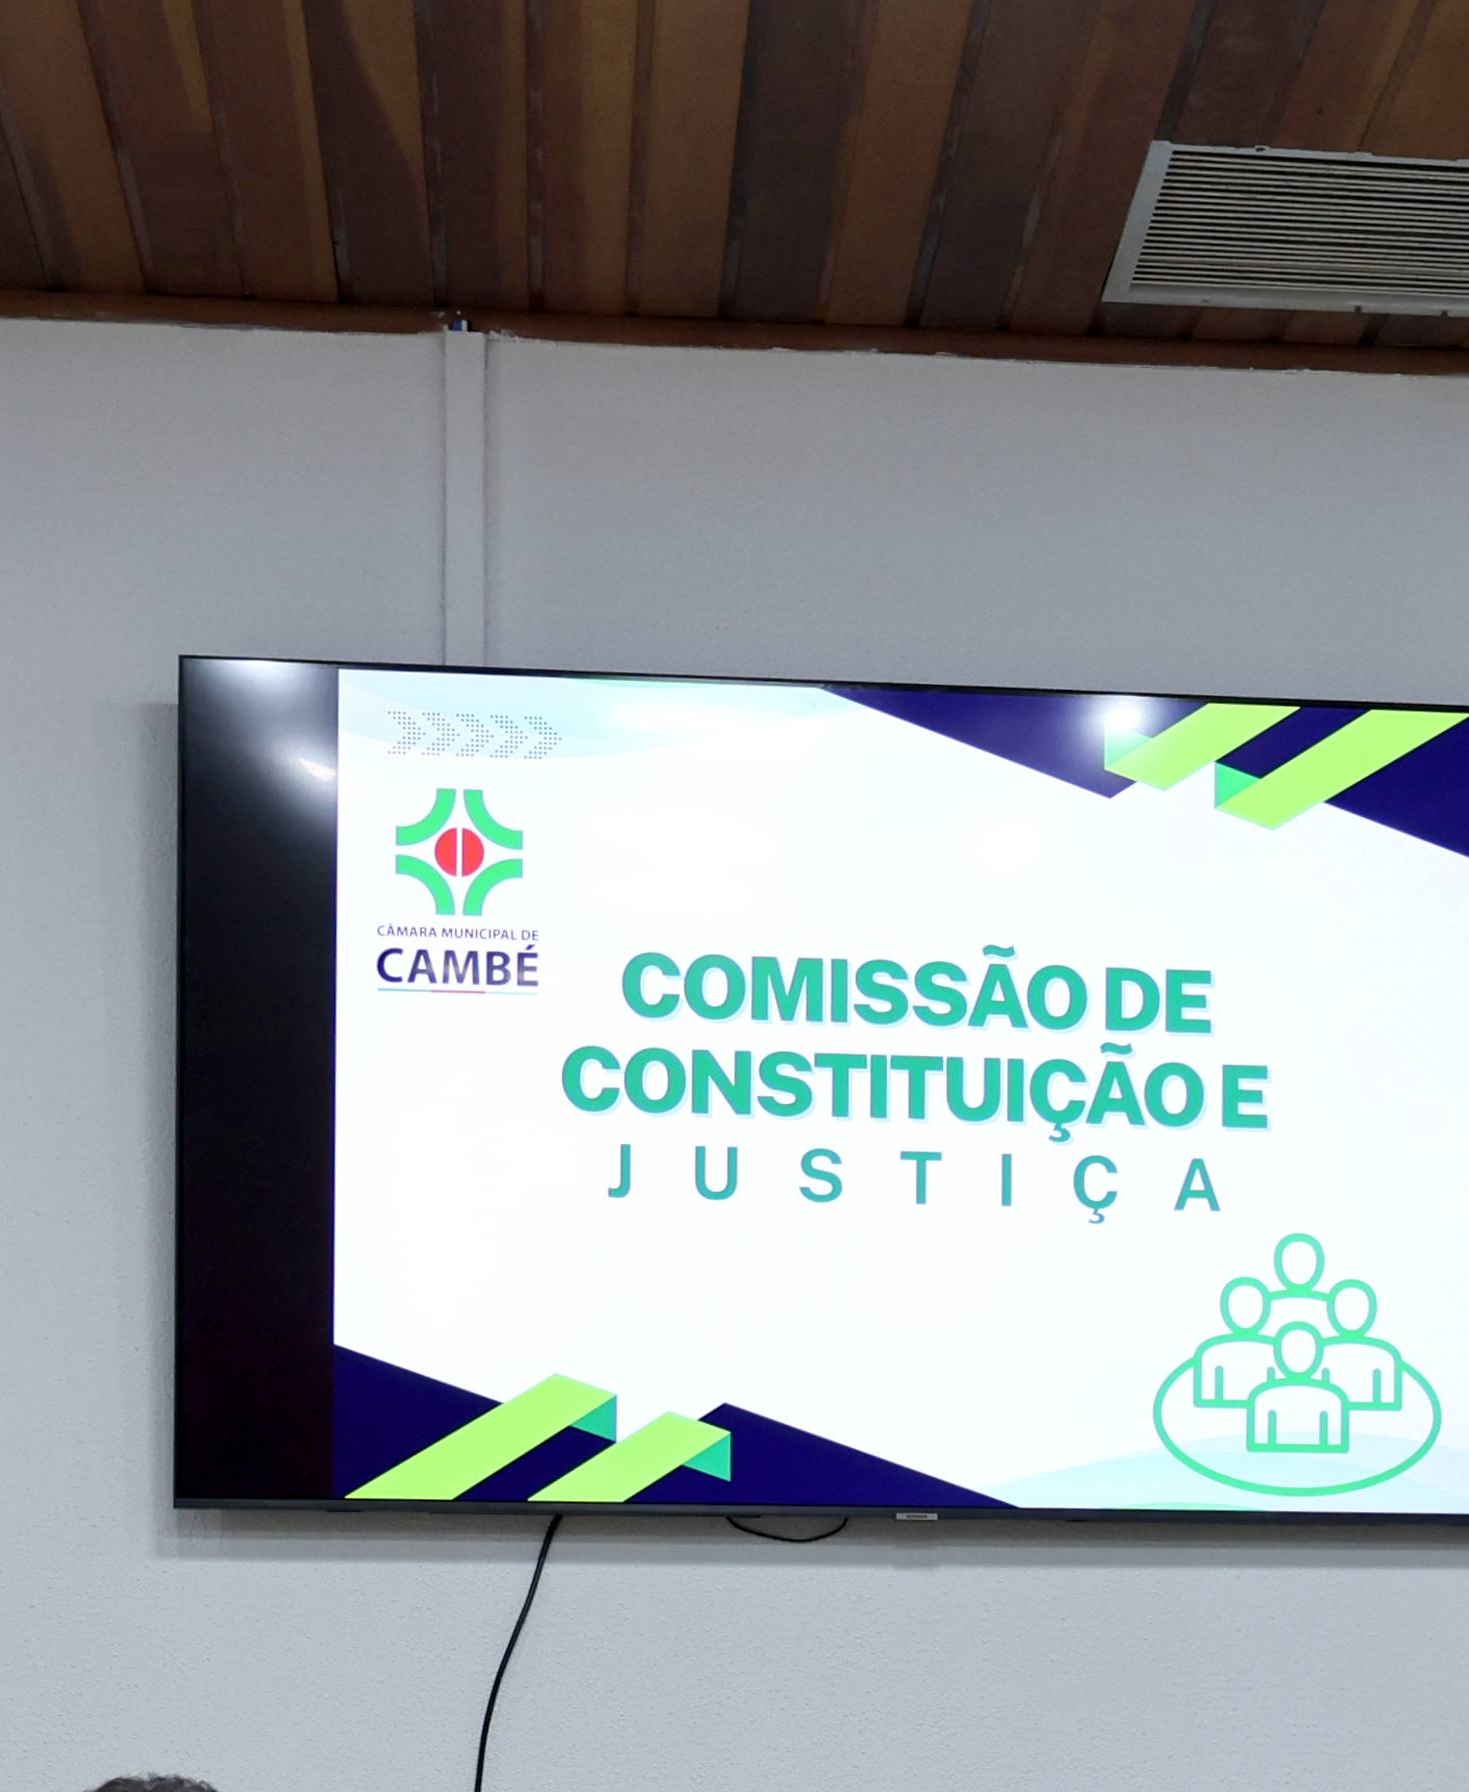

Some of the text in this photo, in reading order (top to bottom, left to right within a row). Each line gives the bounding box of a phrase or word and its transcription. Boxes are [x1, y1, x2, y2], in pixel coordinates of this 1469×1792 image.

[376, 944, 539, 987] CAMBÉ
[377, 923, 539, 941] CÂMARA MUNICIPAL DE
[621, 943, 1213, 1035] COMISSÃO DE
[561, 1042, 1270, 1142] CONSTITUIÇÃO E
[607, 1143, 1221, 1224] JUSTIÇA
